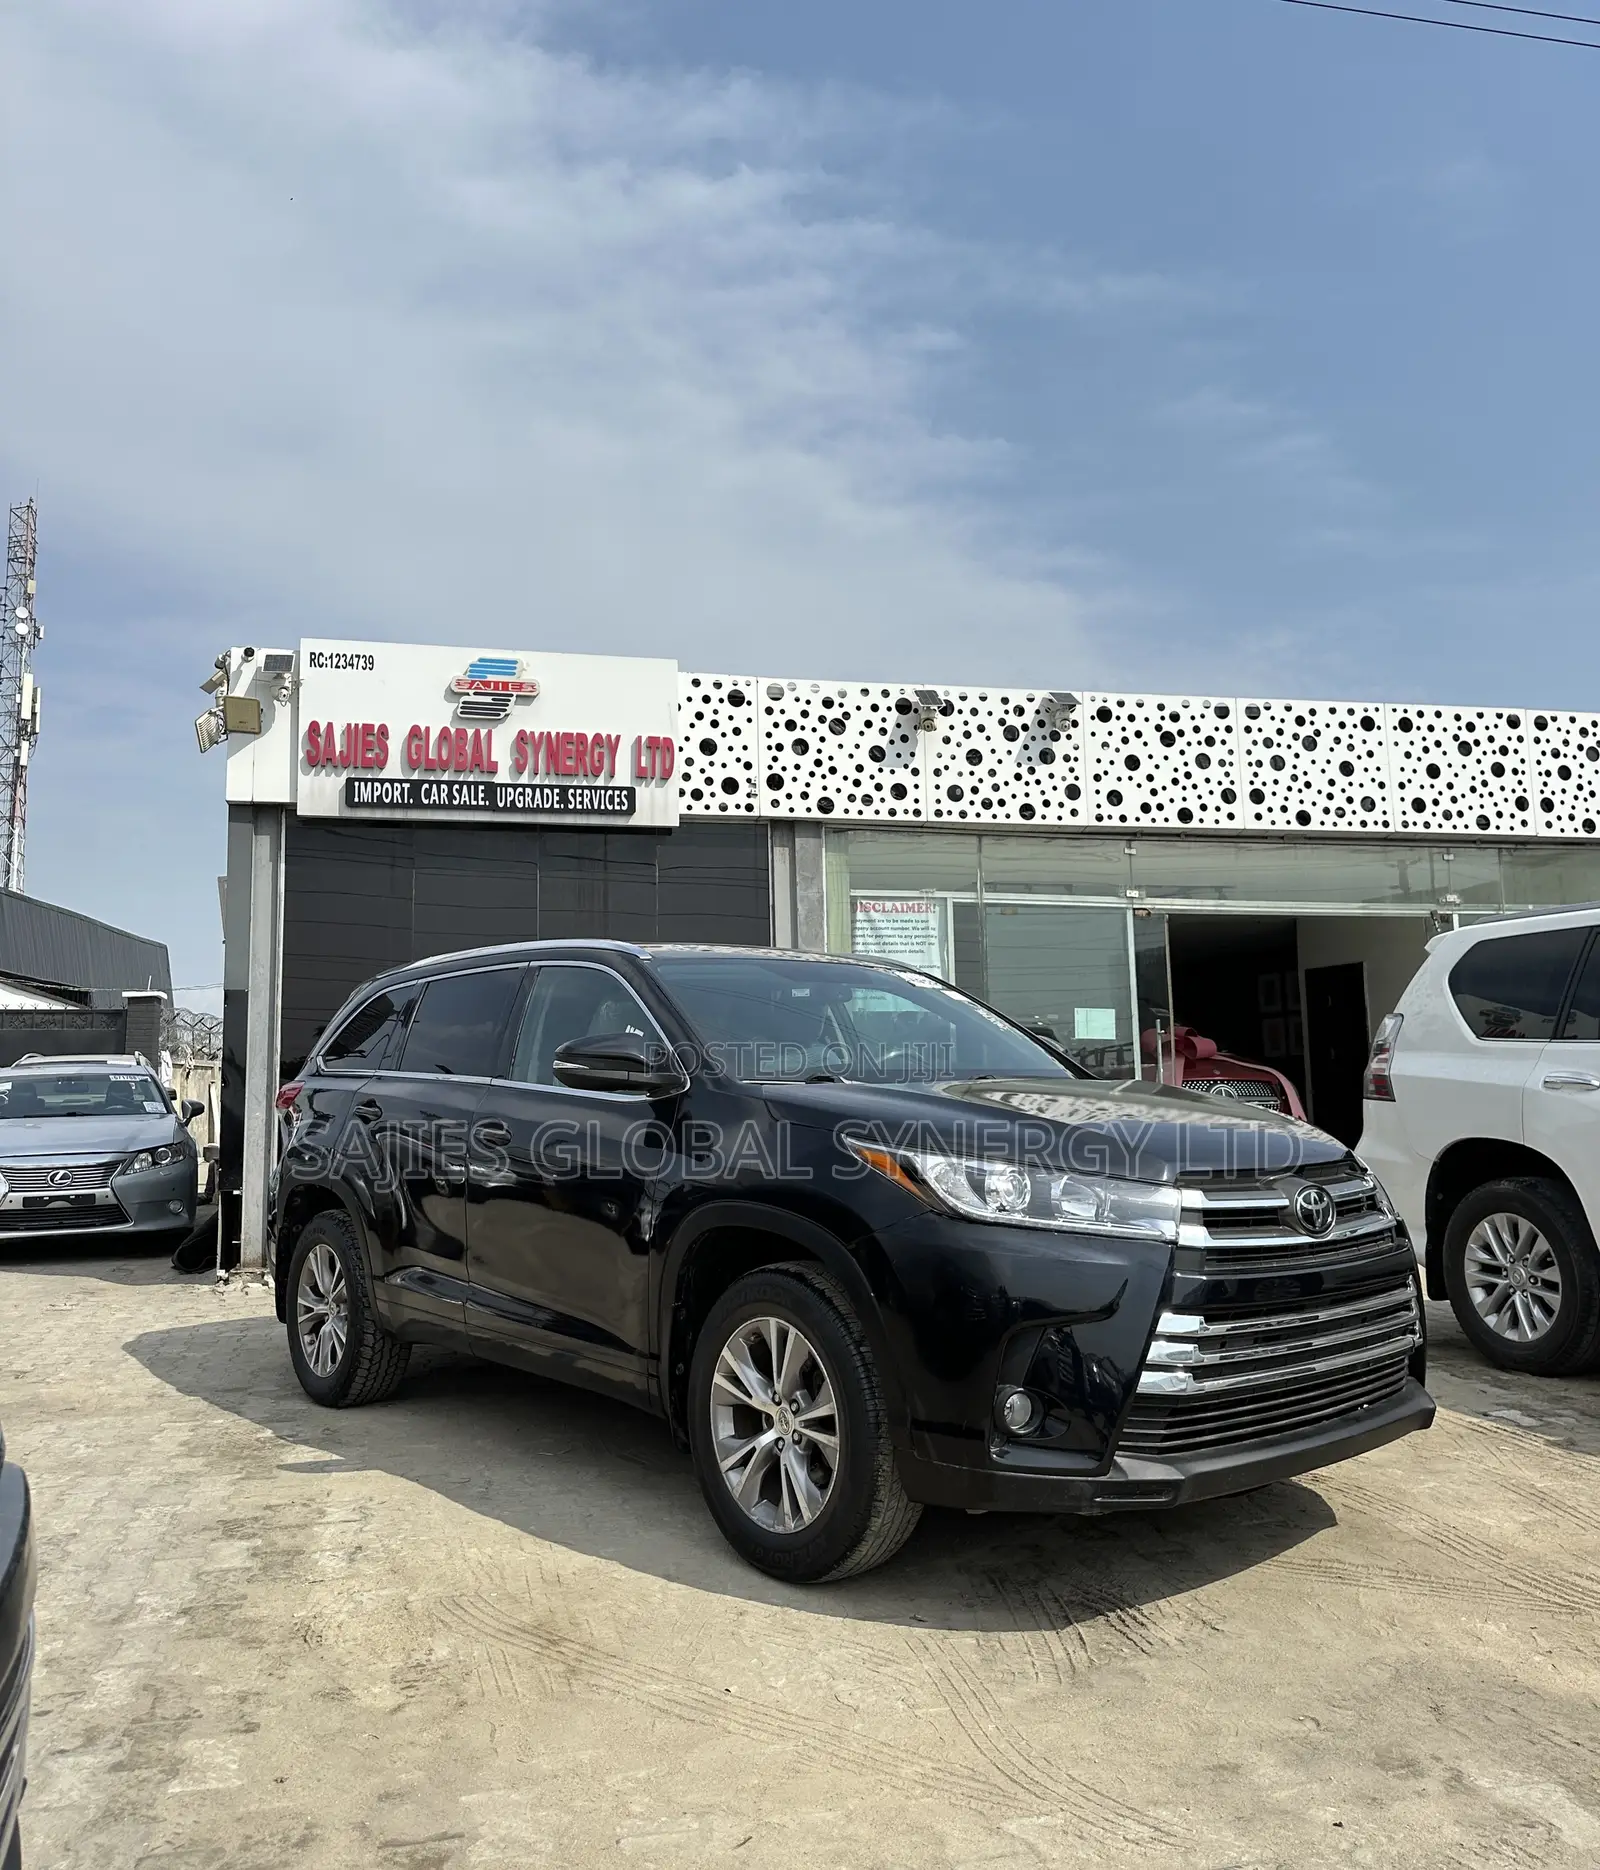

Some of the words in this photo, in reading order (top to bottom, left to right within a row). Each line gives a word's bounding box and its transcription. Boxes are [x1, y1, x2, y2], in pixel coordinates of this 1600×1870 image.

[309, 651, 375, 671] RC:1234739
[456, 678, 537, 692] SAJIES
[306, 720, 390, 769] SAJIES
[407, 725, 499, 774] GLOBAL
[515, 729, 621, 777] SYNERGY
[636, 736, 675, 780] LTD
[353, 781, 414, 804] IMPORT.
[420, 785, 450, 805] CAR
[452, 786, 490, 807] SALE.
[496, 788, 564, 808] UPGRADE.
[567, 789, 629, 810] SERVICES
